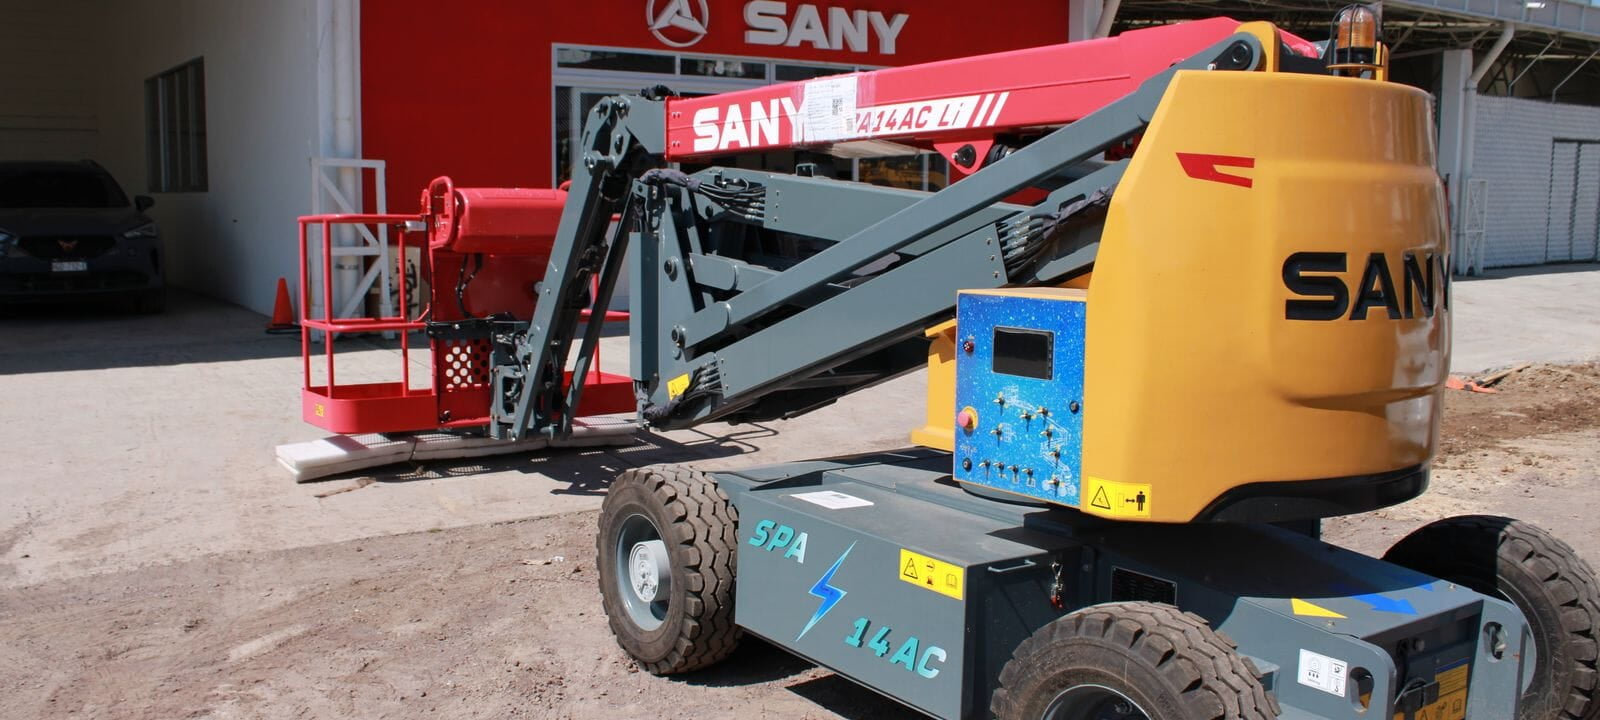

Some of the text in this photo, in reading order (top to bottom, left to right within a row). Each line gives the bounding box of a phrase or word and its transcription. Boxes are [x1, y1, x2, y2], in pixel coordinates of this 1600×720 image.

[743, 0, 909, 54] SANY
[693, 97, 805, 152] SANY
[938, 102, 965, 127] Li
[748, 519, 809, 564] SPA
[844, 616, 947, 679] 14AC
